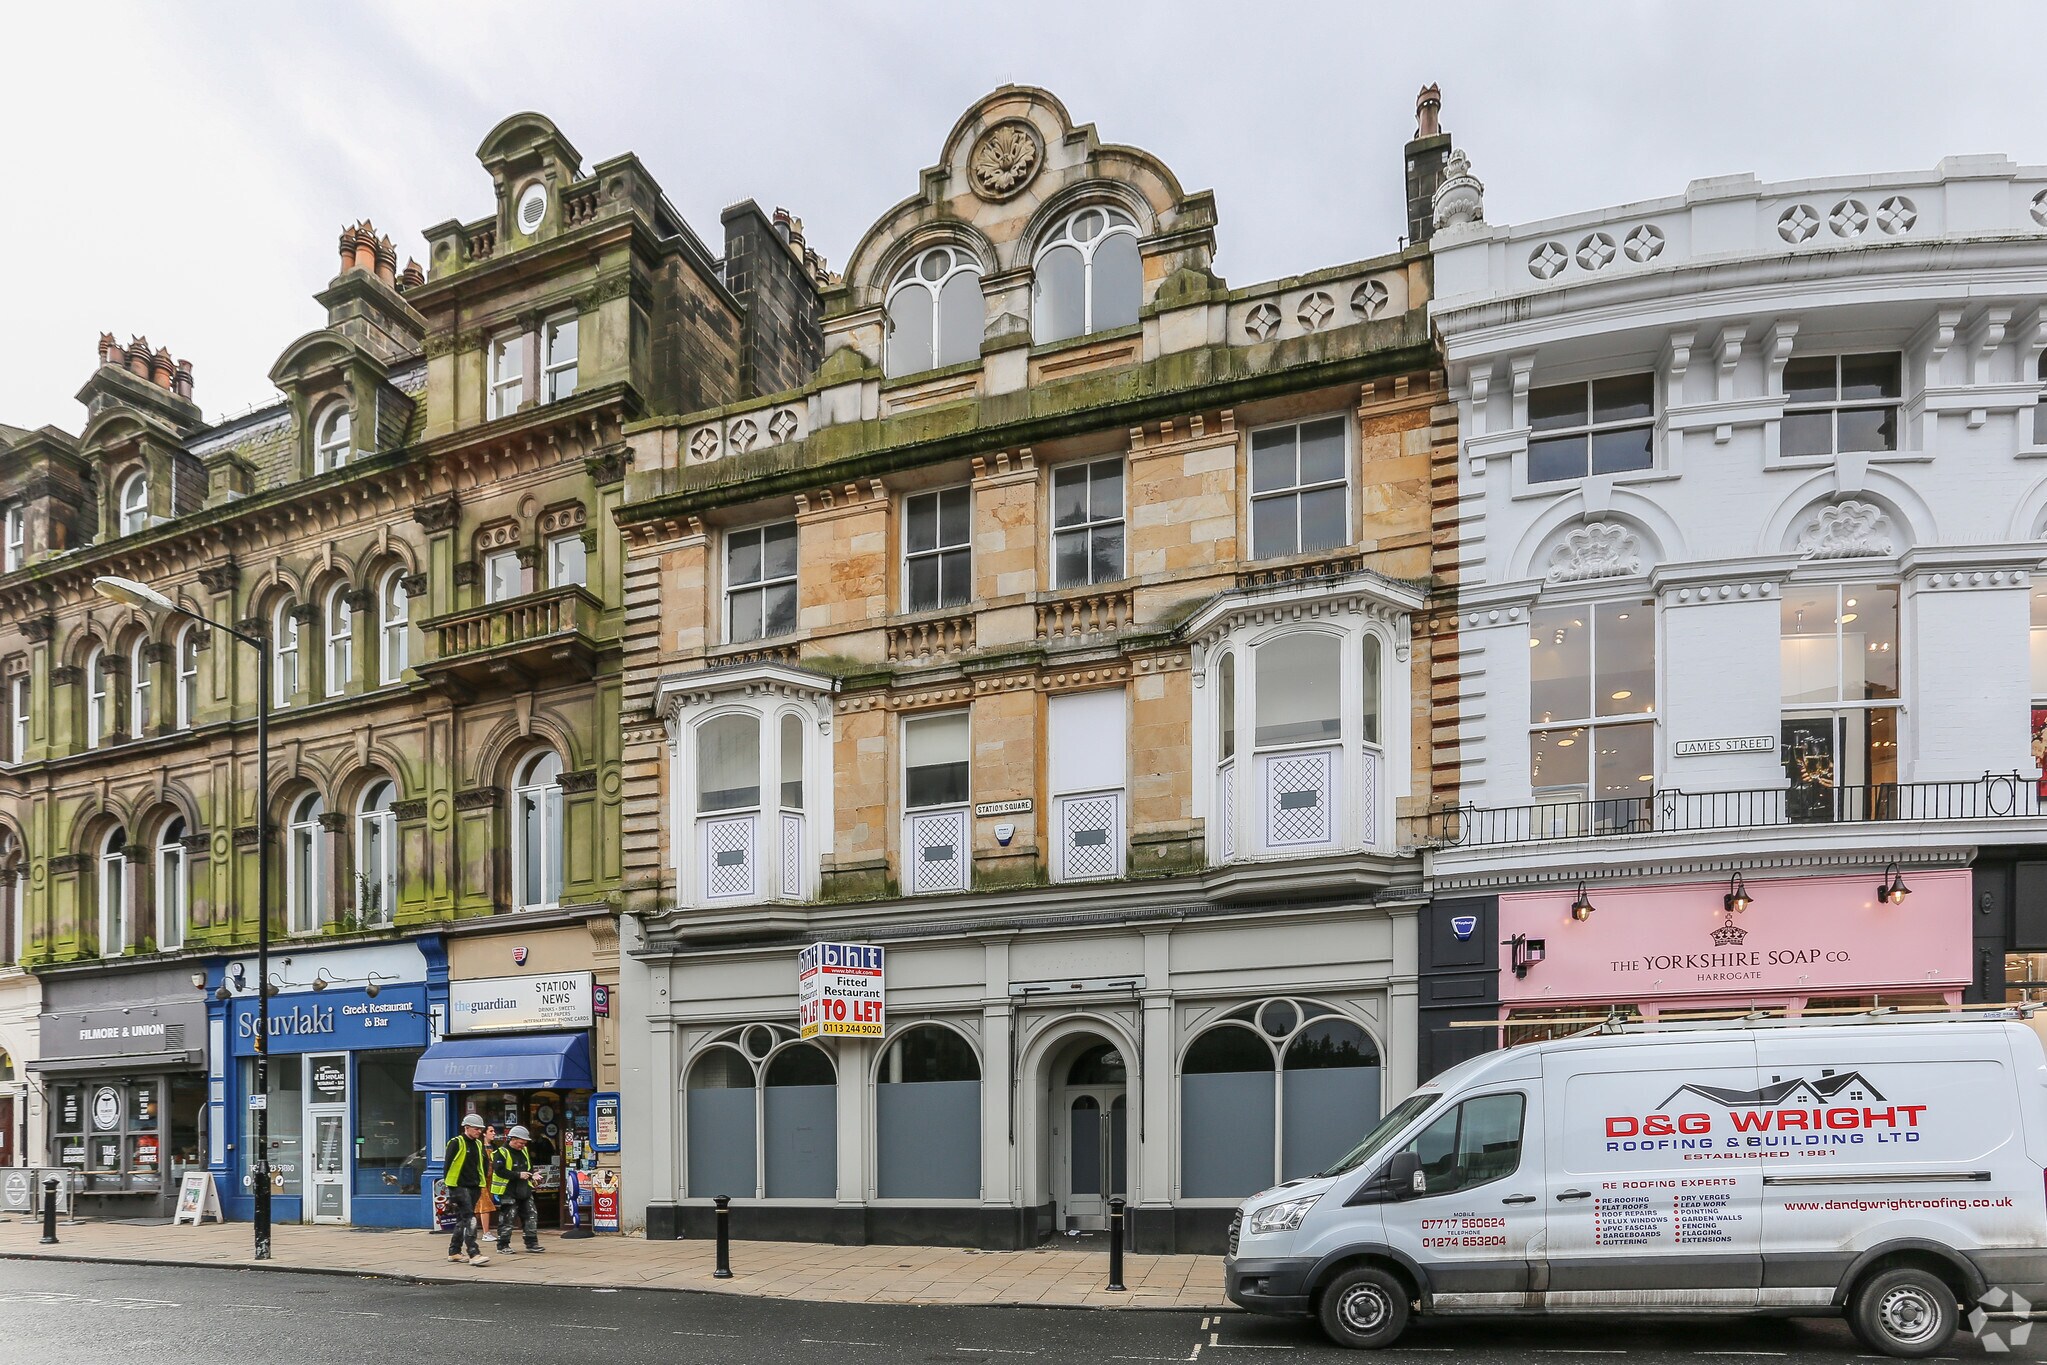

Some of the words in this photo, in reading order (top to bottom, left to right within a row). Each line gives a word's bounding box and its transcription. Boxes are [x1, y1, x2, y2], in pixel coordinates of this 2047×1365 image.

[1682, 741, 1721, 753] JAMES
[1726, 738, 1769, 750] STREET
[978, 804, 1003, 814] STATION
[1004, 801, 1030, 811] SQUARE
[800, 945, 818, 973] bht
[824, 944, 878, 968] bht
[1610, 960, 1640, 972] THE
[1643, 951, 1760, 970] YORKSHIRE
[1768, 949, 1821, 966] SOAP
[1825, 951, 1851, 963] CO.
[831, 968, 874, 976] www.bht.uk.com
[1697, 971, 1762, 982] HARROGATE
[535, 980, 577, 993] STATION
[837, 976, 868, 987] Fitted
[824, 986, 880, 998] Restaurant
[542, 993, 570, 1004] NEWS
[342, 1003, 368, 1015] Greek
[369, 1001, 413, 1014] Restaurant
[454, 997, 517, 1014] theguardian
[822, 998, 847, 1021] TO
[854, 1000, 882, 1022] LET
[801, 1003, 808, 1027] TO
[809, 999, 819, 1024] LET
[364, 1019, 372, 1027] &
[373, 1017, 388, 1027] Bar
[80, 1027, 119, 1040] FILMORE
[122, 1027, 130, 1037] &
[132, 1023, 164, 1036] UNION
[823, 1023, 844, 1033] 0113
[846, 1024, 860, 1033] 244
[862, 1025, 882, 1034] 9020
[1605, 1112, 1712, 1138] D&G
[1729, 1104, 1927, 1132] WRIGHT
[1606, 1138, 1713, 1152] ROOFING
[1726, 1137, 1740, 1148] &
[1746, 1133, 1864, 1147] BUILDING
[1878, 1131, 1921, 1144] LTD
[1683, 1150, 1790, 1161] ESTABLISHED
[1797, 1149, 1836, 1158] 1981
[1602, 1182, 1617, 1190] RE
[1622, 1180, 1676, 1189] ROOFING
[1681, 1178, 1737, 1187] EXPERTS
[1602, 1196, 1650, 1204] RE-ROOFING
[1784, 1196, 2013, 1212] www.dandgwrightroofing.co.uk
[1421, 1219, 1458, 1229] 07717
[1461, 1217, 1506, 1229] 560624
[1422, 1237, 1458, 1247] 01274
[1462, 1235, 1506, 1246] 653204
[1603, 1231, 1661, 1239] BARGEBOARDS
[1603, 1238, 1648, 1246] GUTTERING
